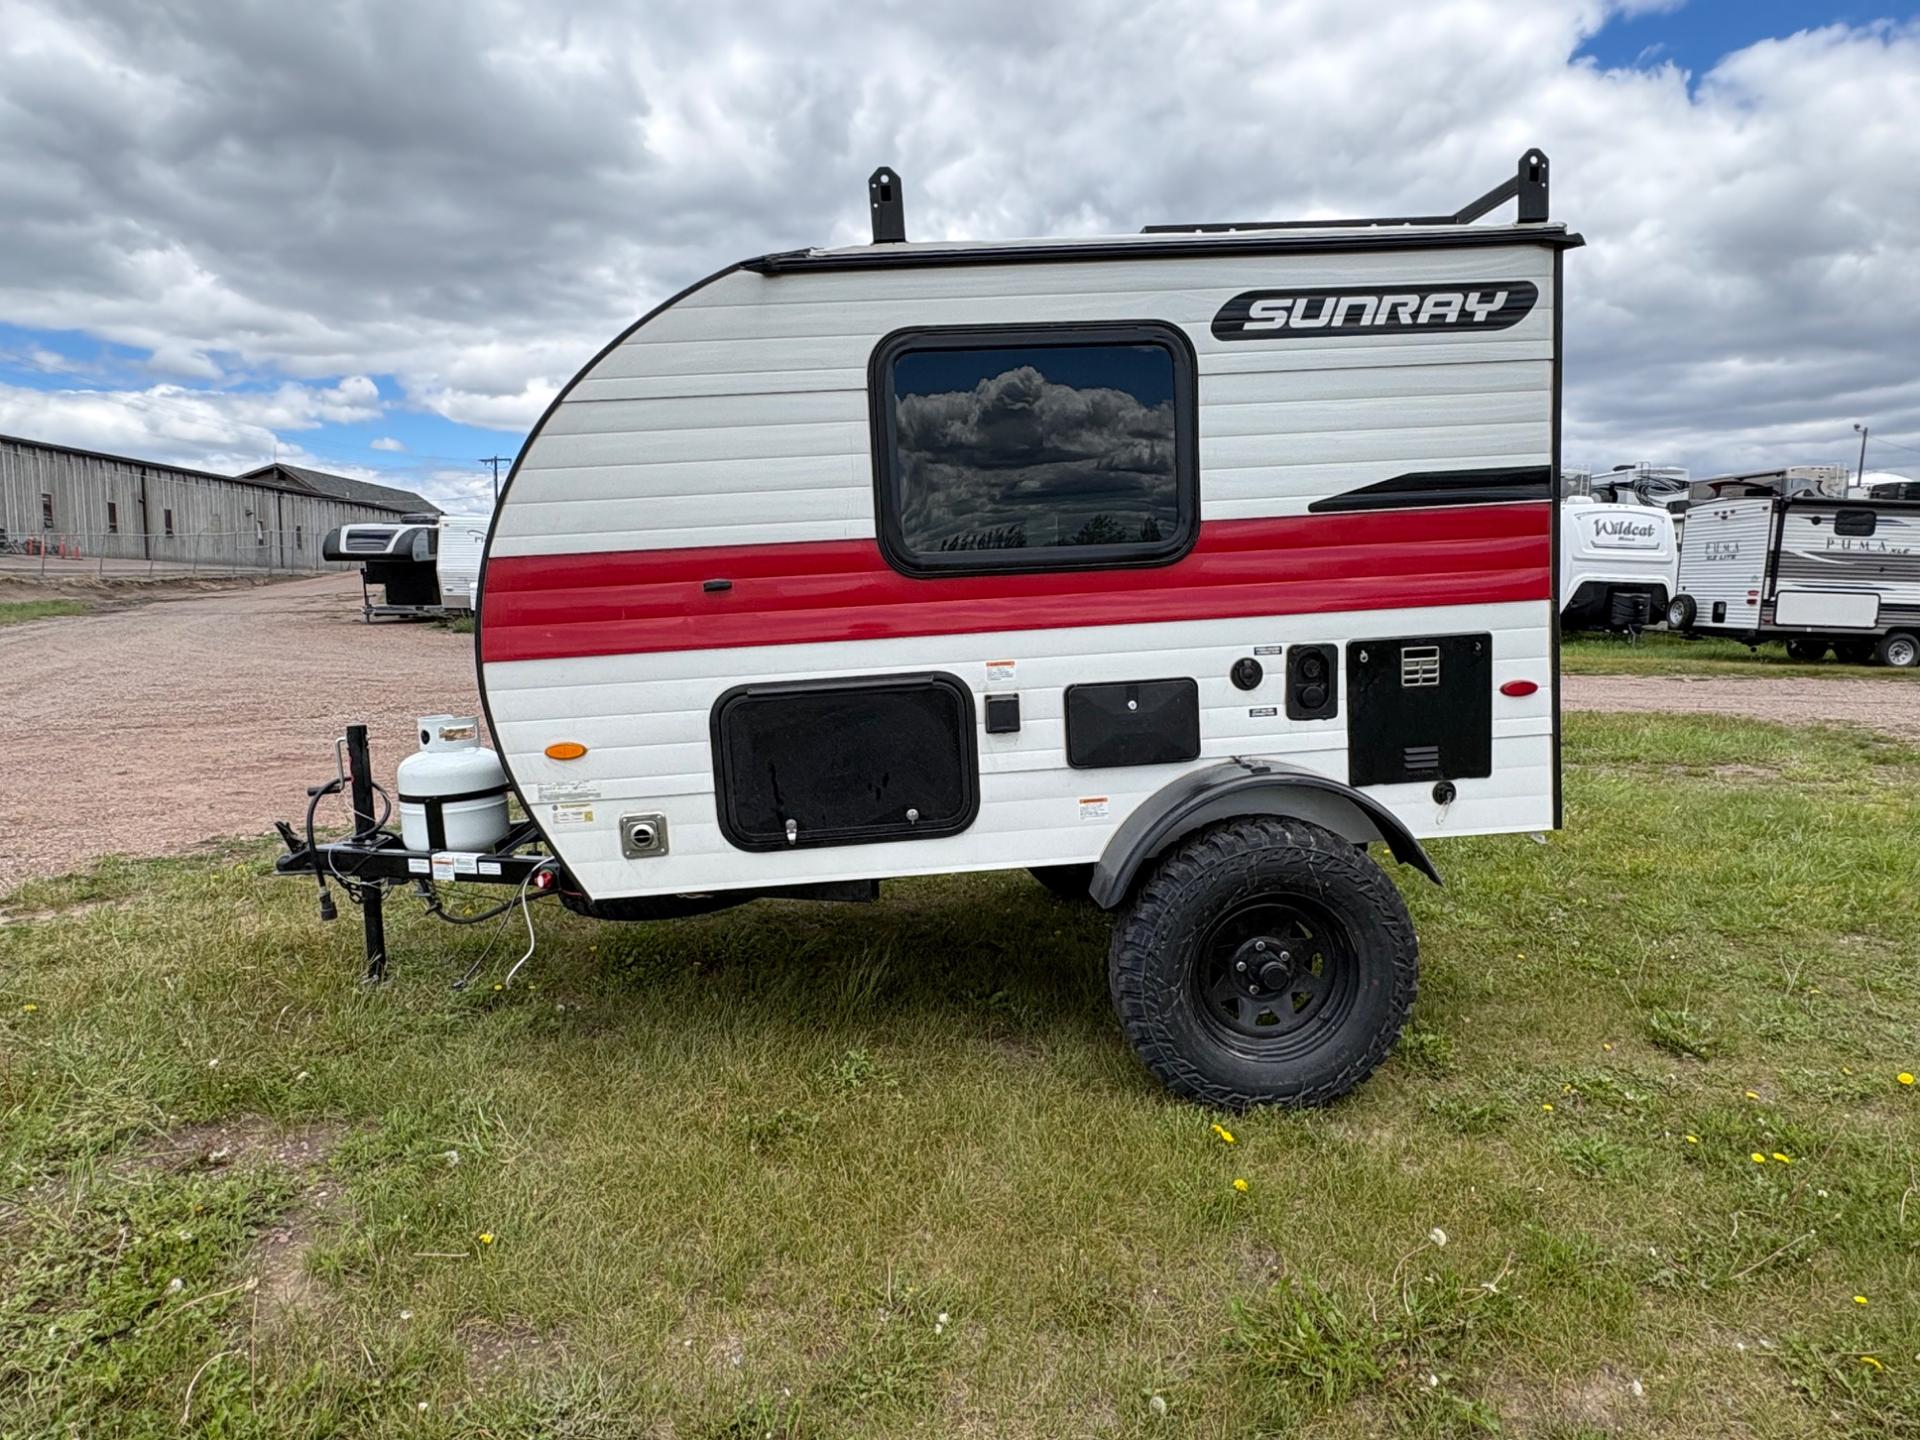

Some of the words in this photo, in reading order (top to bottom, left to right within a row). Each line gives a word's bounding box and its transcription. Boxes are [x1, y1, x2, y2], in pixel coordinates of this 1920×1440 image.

[1243, 290, 1509, 331] SUNRAY
[1593, 518, 1655, 537] Wildcat
[1826, 537, 1887, 551] PUMA
